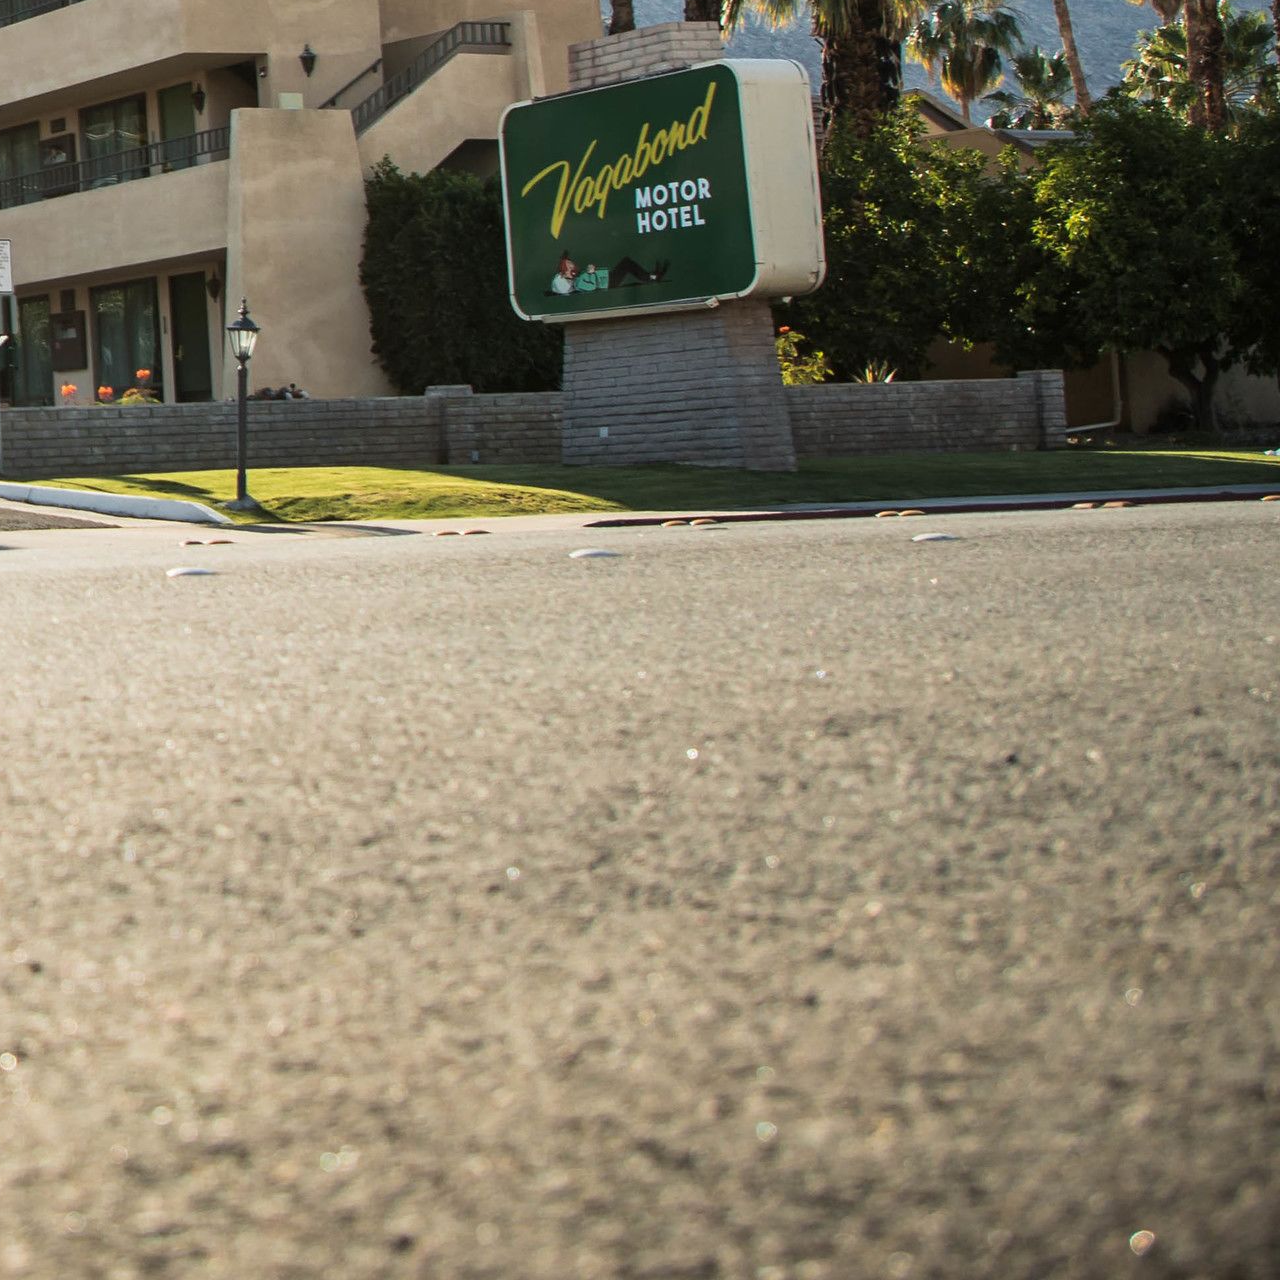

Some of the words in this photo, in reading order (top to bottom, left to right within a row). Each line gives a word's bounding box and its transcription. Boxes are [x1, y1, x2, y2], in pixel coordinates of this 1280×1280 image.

[521, 82, 716, 239] Vagabond
[635, 178, 711, 209] MOTOR
[637, 204, 706, 234] HOTEL
